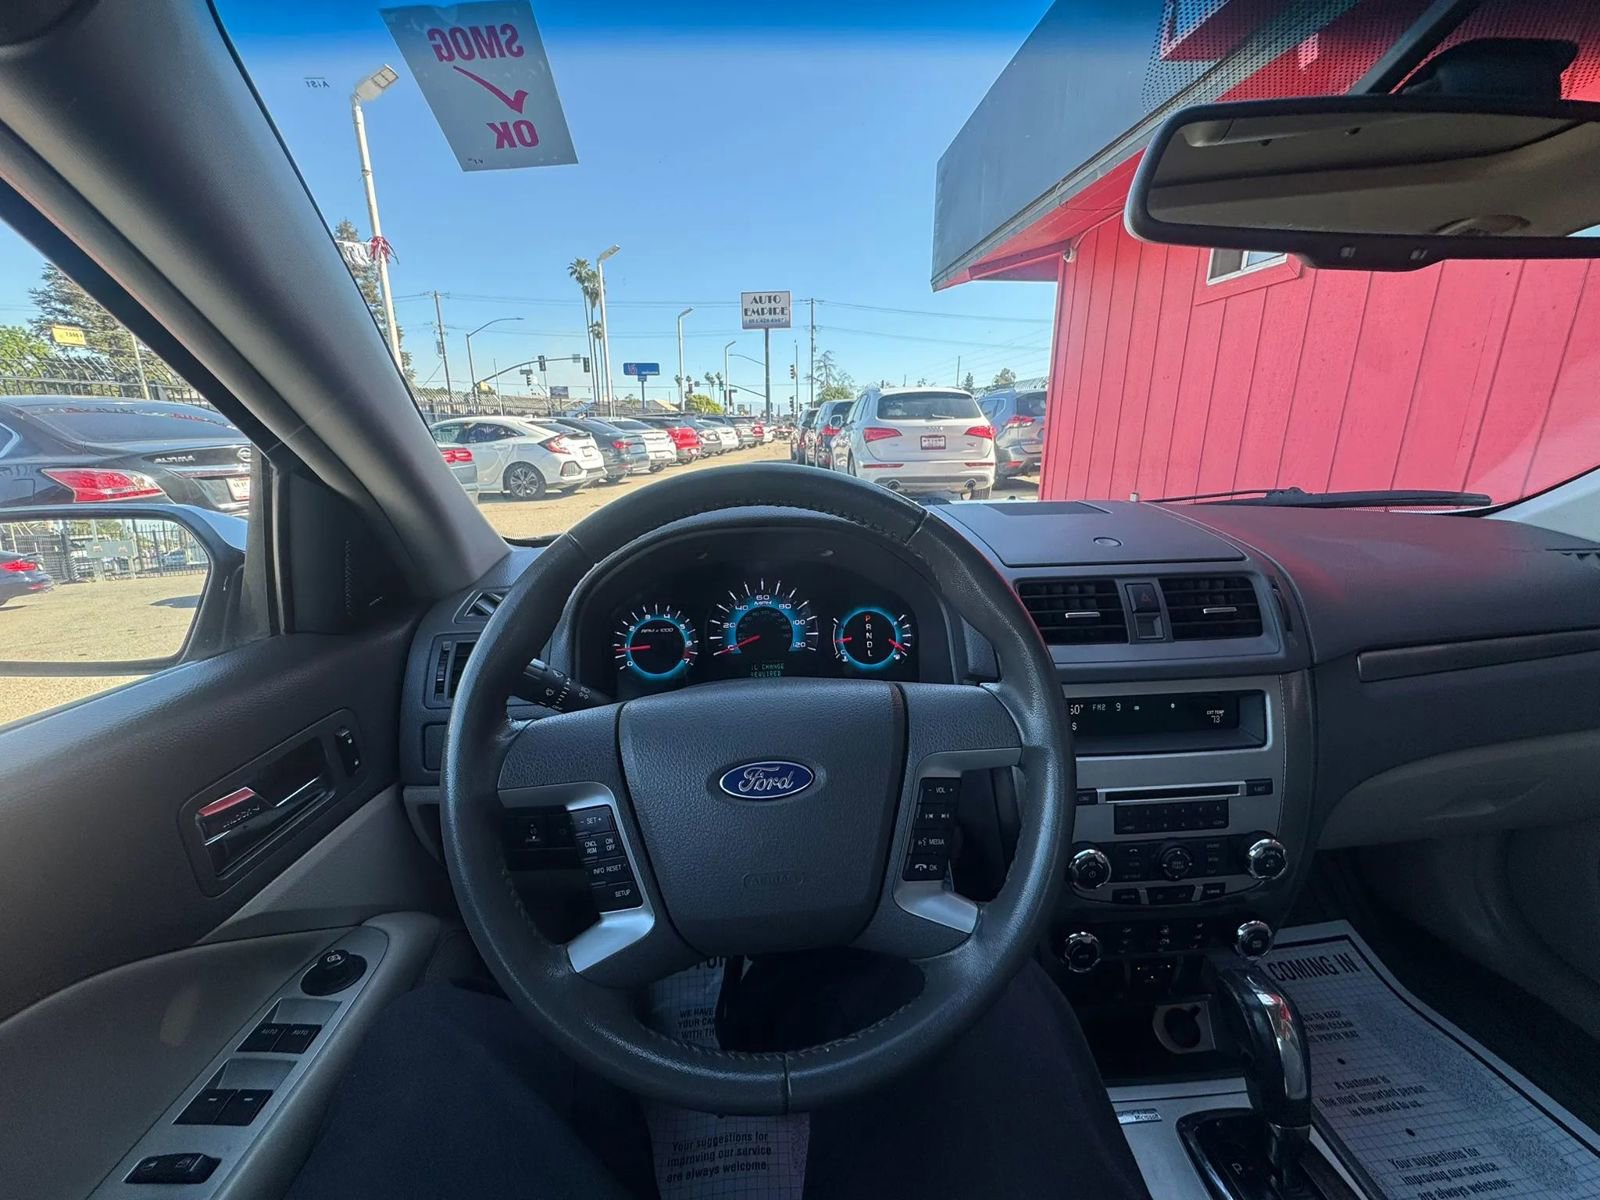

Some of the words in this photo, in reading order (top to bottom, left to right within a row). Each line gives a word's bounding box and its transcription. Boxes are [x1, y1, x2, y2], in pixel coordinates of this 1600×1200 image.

[750, 295, 782, 305] AUTO
[743, 306, 788, 317] EMPIRE
[154, 455, 195, 463] ALTIMA
[1092, 703, 1106, 711] FM2
[738, 766, 794, 793] Ford
[593, 867, 605, 875] INFO
[606, 864, 622, 872] RESET
[614, 889, 631, 897] SETUP
[1268, 955, 1340, 981] COMING
[1332, 952, 1361, 973] IN
[679, 1009, 691, 1018] WE
[693, 1007, 714, 1016] HAVE
[677, 1018, 700, 1028] YOUR
[681, 1030, 702, 1039] WITH
[1334, 1081, 1344, 1090] A
[1342, 1077, 1380, 1089] customer
[1319, 1095, 1336, 1106] the
[1335, 1093, 1358, 1105] most
[1355, 1088, 1392, 1103] important
[1391, 1085, 1426, 1097] person
[672, 1141, 694, 1151] Your
[696, 1133, 753, 1149] suggestions
[754, 1131, 769, 1141] for
[667, 1151, 716, 1168] improving
[717, 1148, 734, 1159] our
[736, 1146, 772, 1156] service
[1389, 1157, 1414, 1170] Your
[1411, 1150, 1467, 1167] suggestions
[1462, 1146, 1481, 1157] for
[666, 1172, 683, 1183] are
[685, 1165, 720, 1181] always
[722, 1160, 771, 1172] welcome.
[1231, 1162, 1243, 1176] P
[1399, 1170, 1452, 1186] improving
[1447, 1168, 1466, 1179] our
[1463, 1161, 1500, 1176] service
[1417, 1190, 1437, 1200] are
[1433, 1185, 1471, 1200] always
